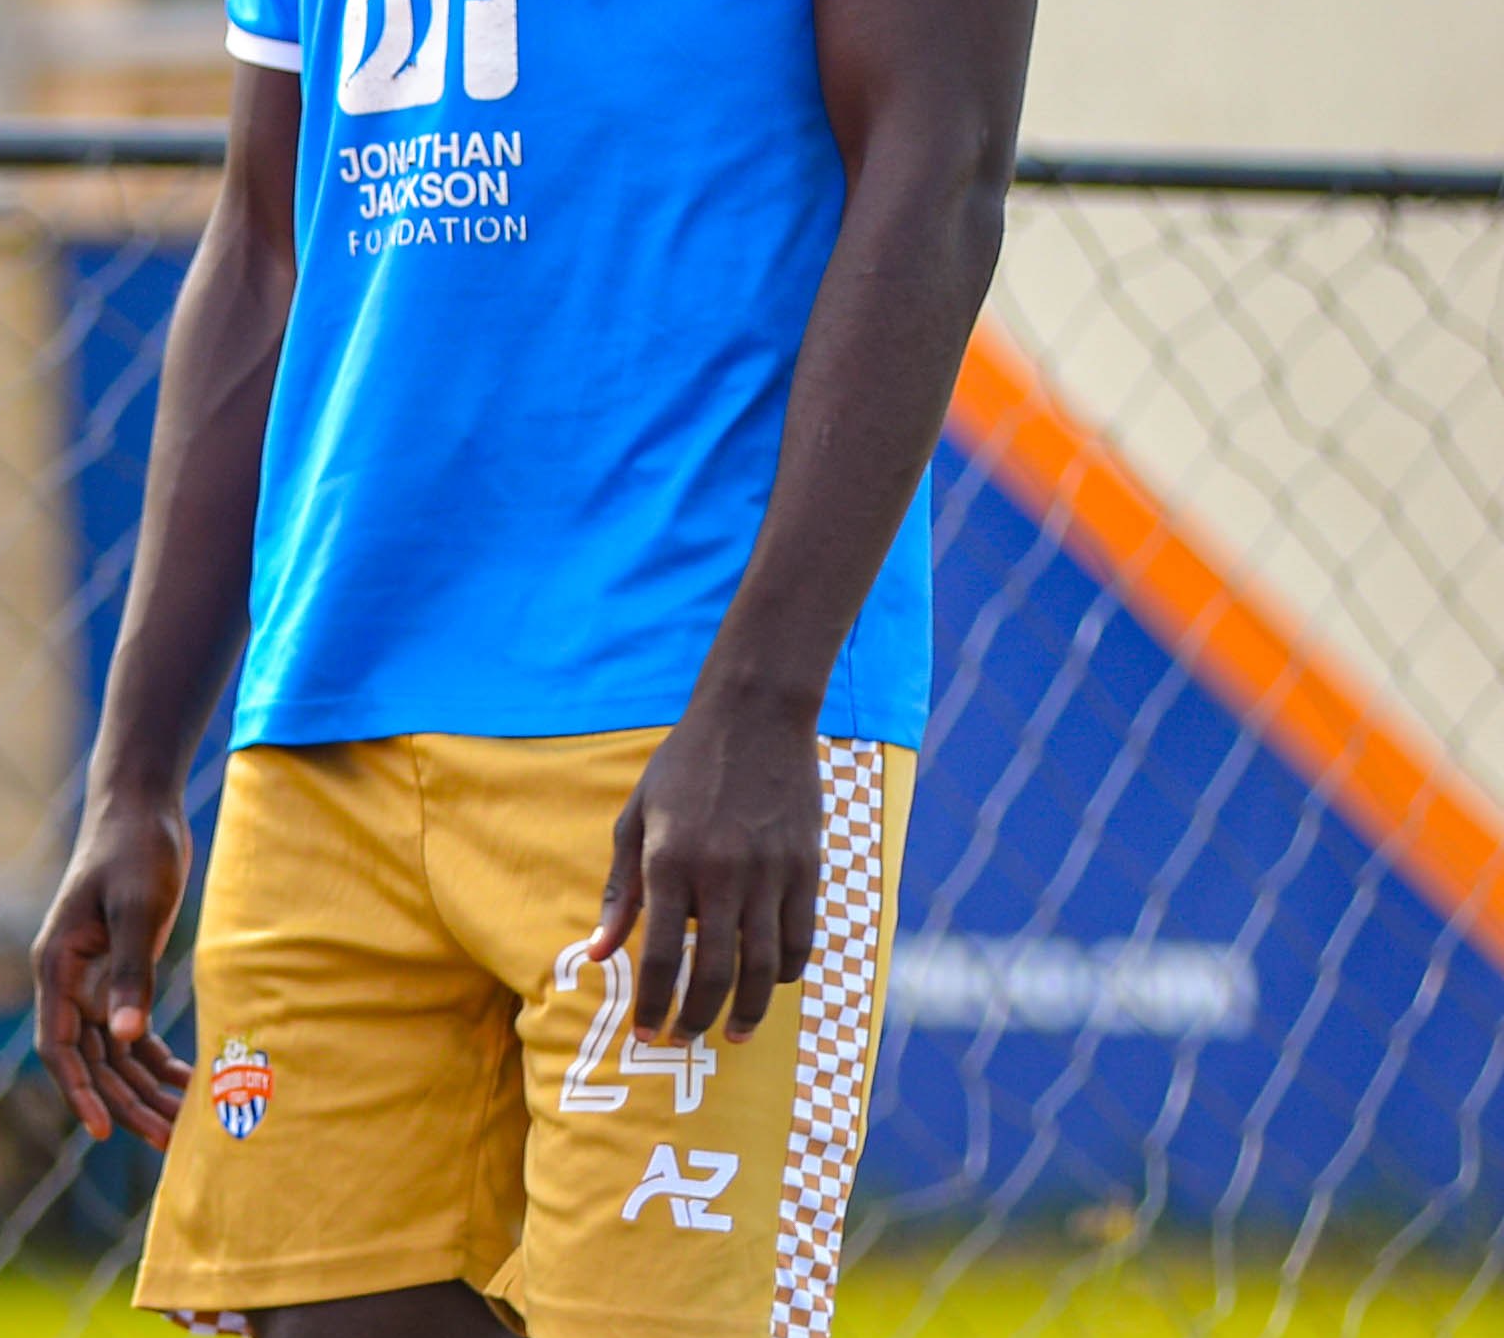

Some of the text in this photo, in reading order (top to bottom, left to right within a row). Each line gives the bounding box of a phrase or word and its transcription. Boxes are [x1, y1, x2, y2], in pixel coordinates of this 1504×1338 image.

[339, 131, 522, 183] JONATHAN
[359, 170, 509, 219] JACKSON
[348, 215, 527, 256] FONDATION
[555, 933, 717, 1114] 24
